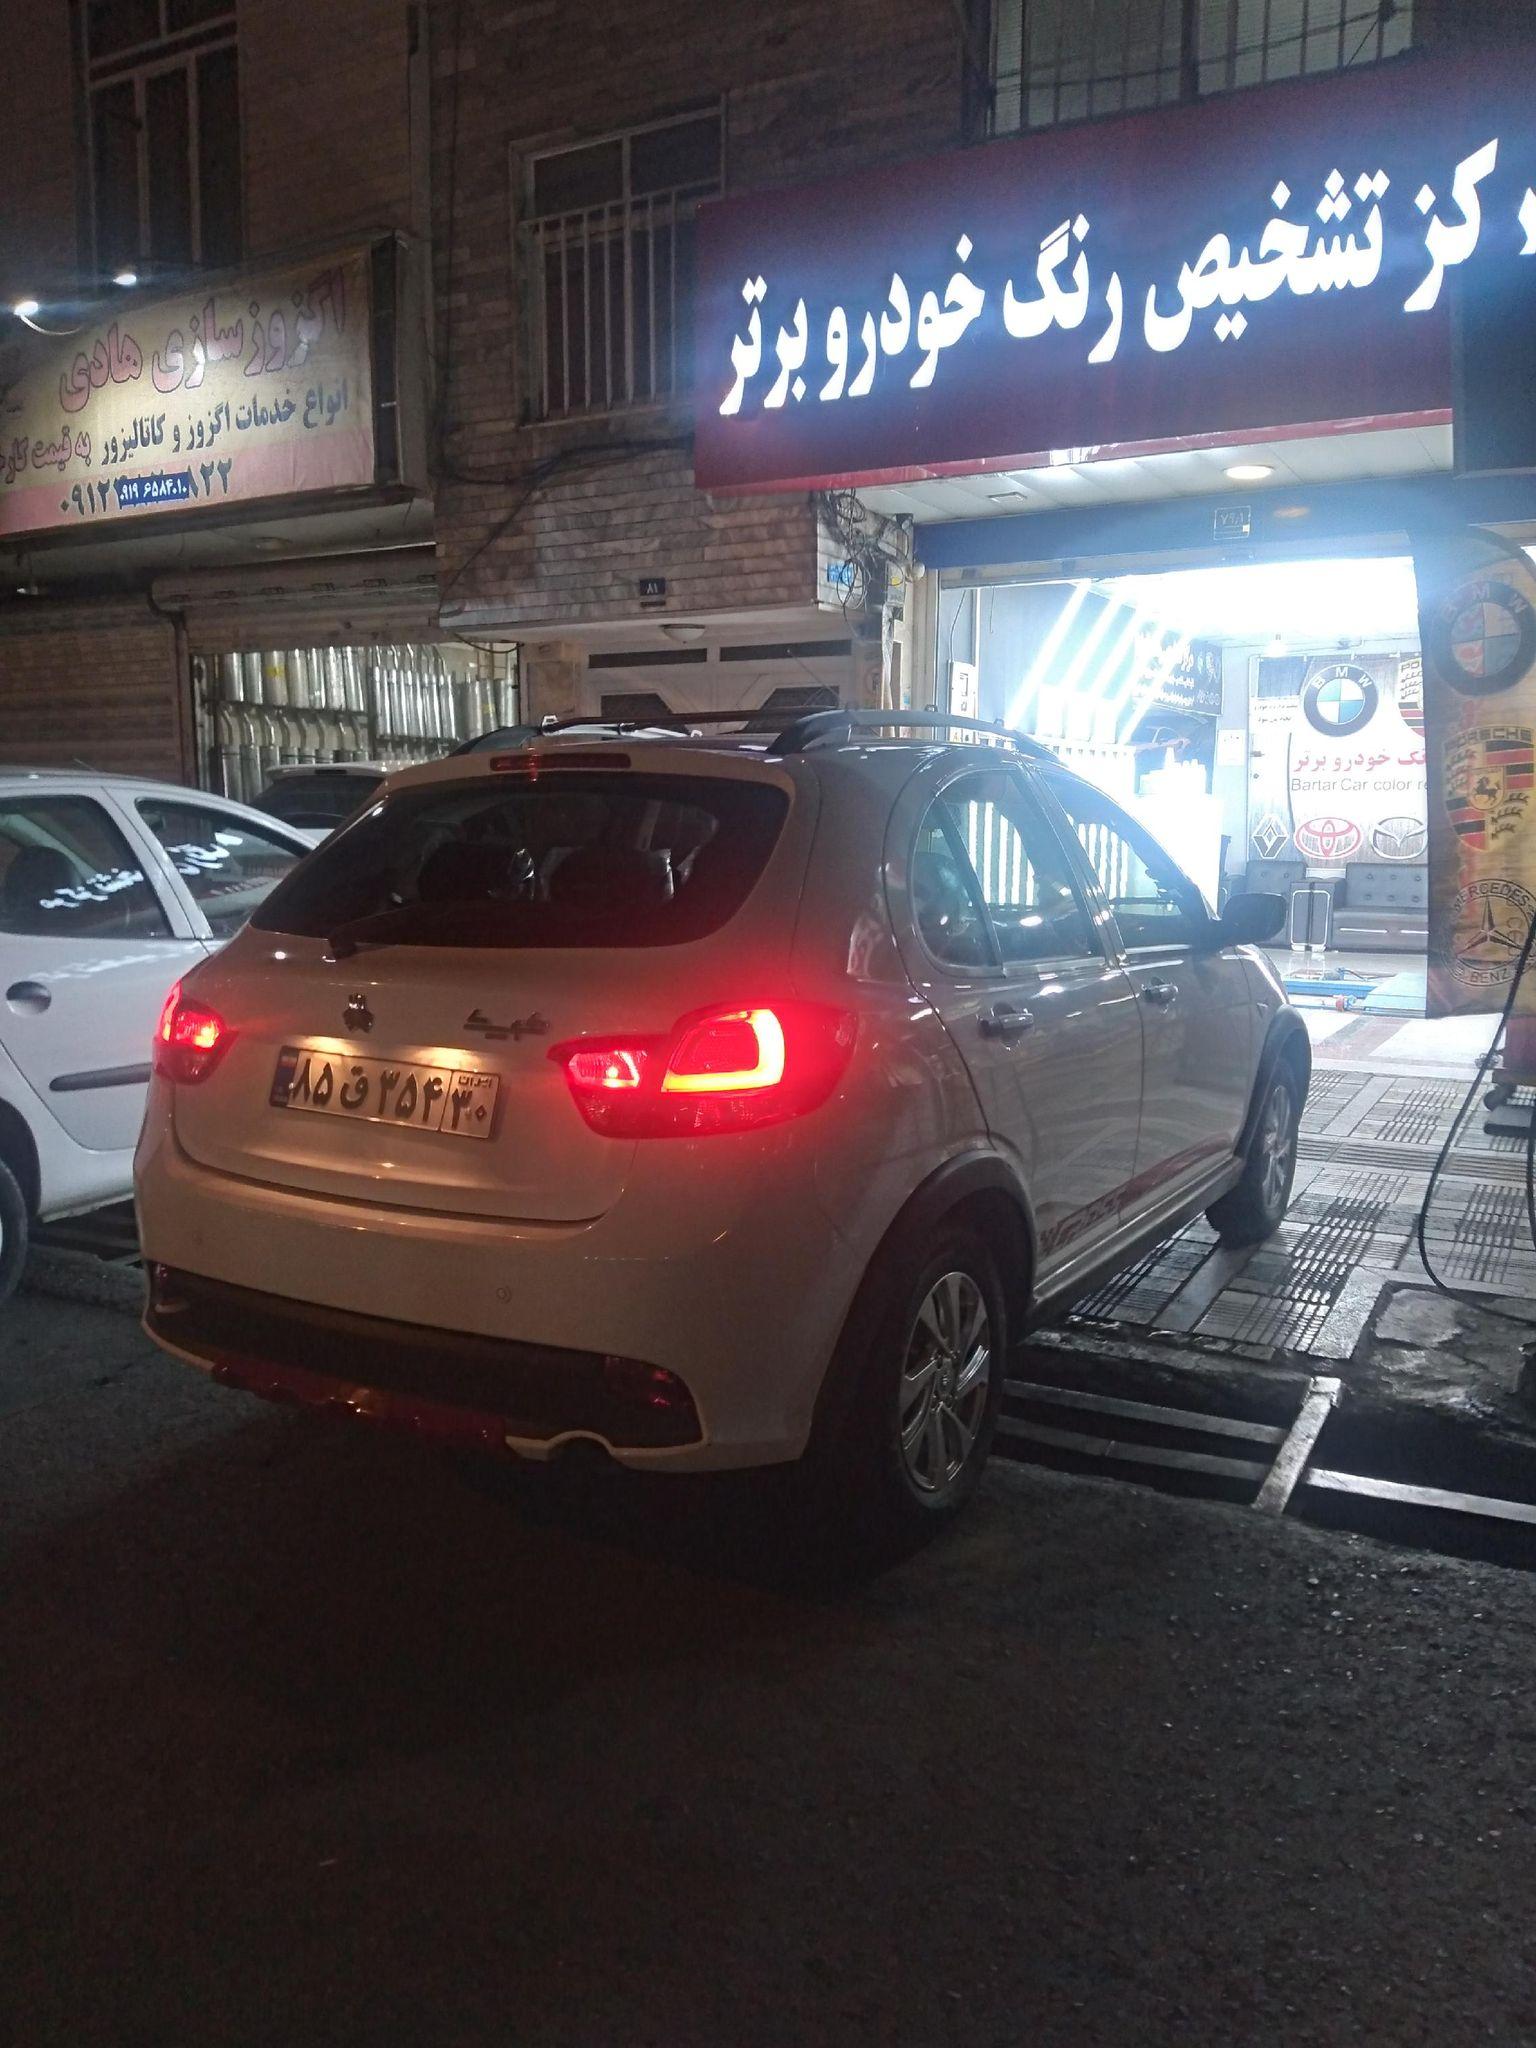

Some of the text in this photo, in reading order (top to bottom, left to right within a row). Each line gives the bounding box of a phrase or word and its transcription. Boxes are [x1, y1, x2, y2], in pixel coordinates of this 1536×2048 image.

[1143, 167, 1389, 352] تشخیص
[1002, 213, 1123, 364] رنگ
[819, 233, 985, 401] خودرو
[59, 322, 143, 413] هادی
[718, 275, 808, 416] برتر
[186, 401, 231, 451] اگزوز
[235, 388, 297, 431] خدمات
[302, 378, 349, 429] انواع
[31, 425, 72, 472] قیمت
[101, 412, 166, 466] کاتالیزور
[172, 424, 181, 453] و
[1311, 665, 1373, 690] BMW
[1332, 748, 1391, 772] خودرو
[1291, 778, 1337, 791] Bartar
[1341, 778, 1368, 791] Car
[1373, 778, 1412, 791] color
[1453, 882, 1530, 914] MERCEDES
[1469, 967, 1511, 984] BENZ
[291, 1057, 443, 1123] ۸۵ ق ۳۵۴
[458, 1072, 493, 1089] ایران
[451, 1087, 489, 1129] ۳۰
